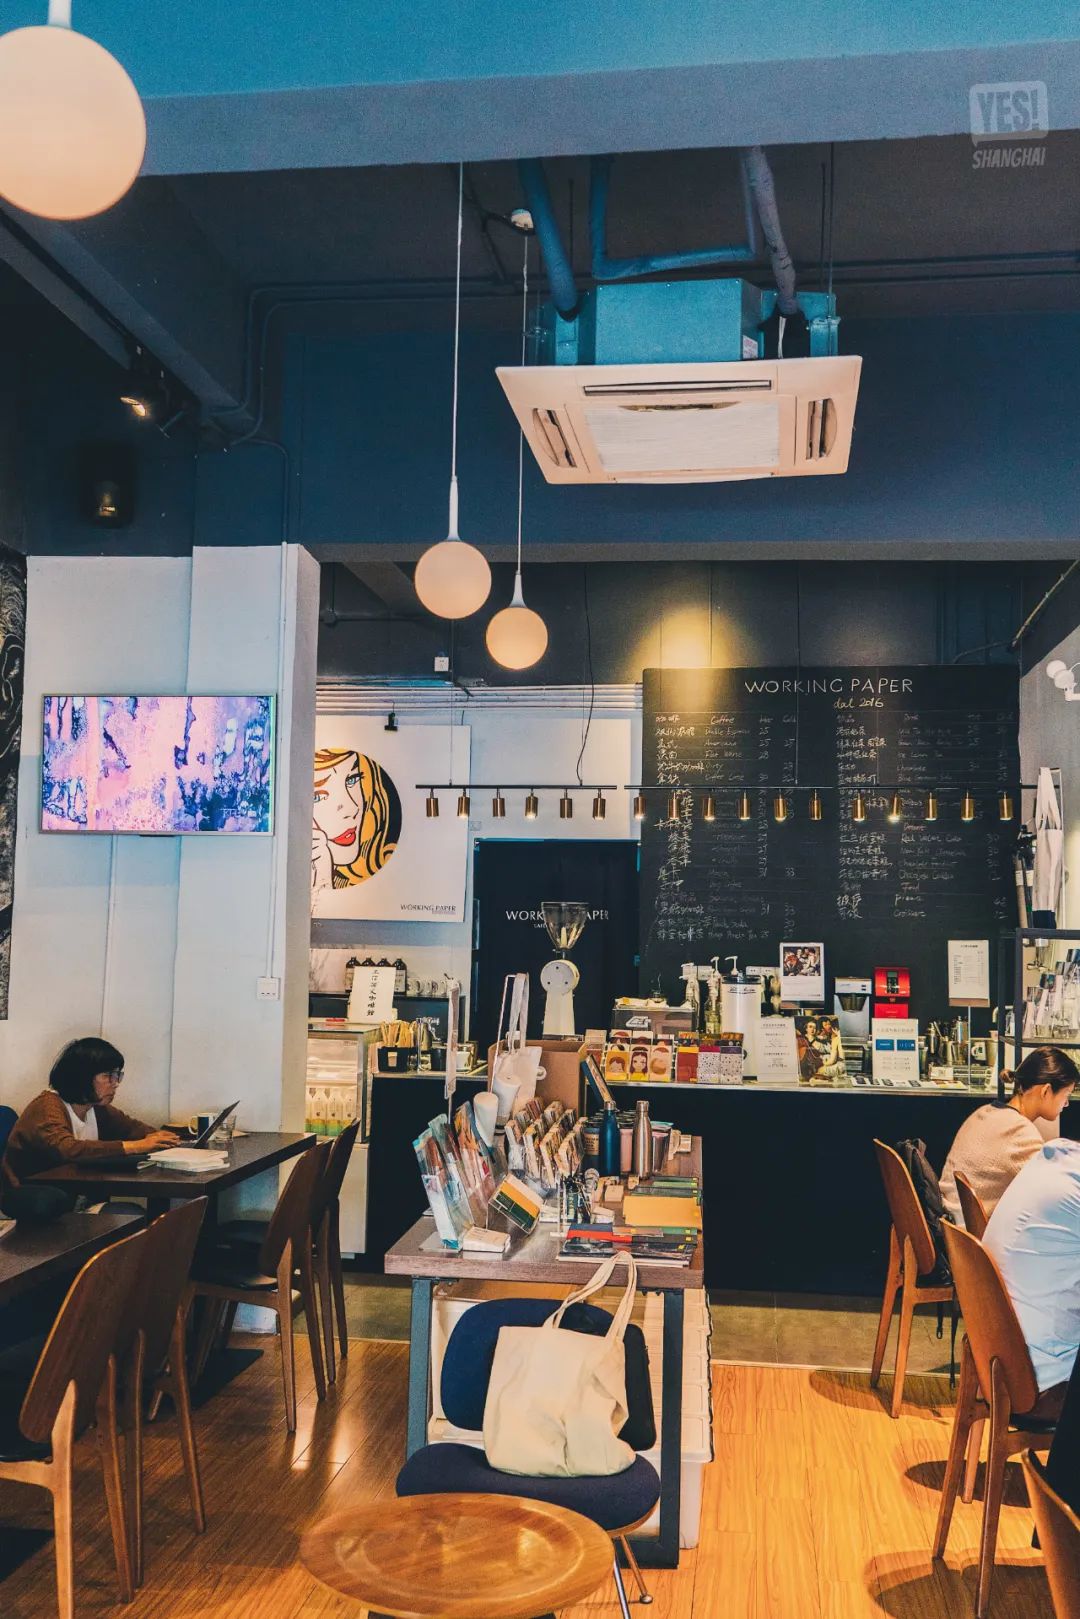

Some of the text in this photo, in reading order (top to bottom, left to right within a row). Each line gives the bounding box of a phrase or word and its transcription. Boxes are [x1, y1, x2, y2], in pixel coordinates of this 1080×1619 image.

[744, 678, 913, 694] WORKING PAPER
[833, 697, 885, 709] dal 2016
[400, 903, 433, 911] WORKING
[505, 910, 545, 920] WORK
